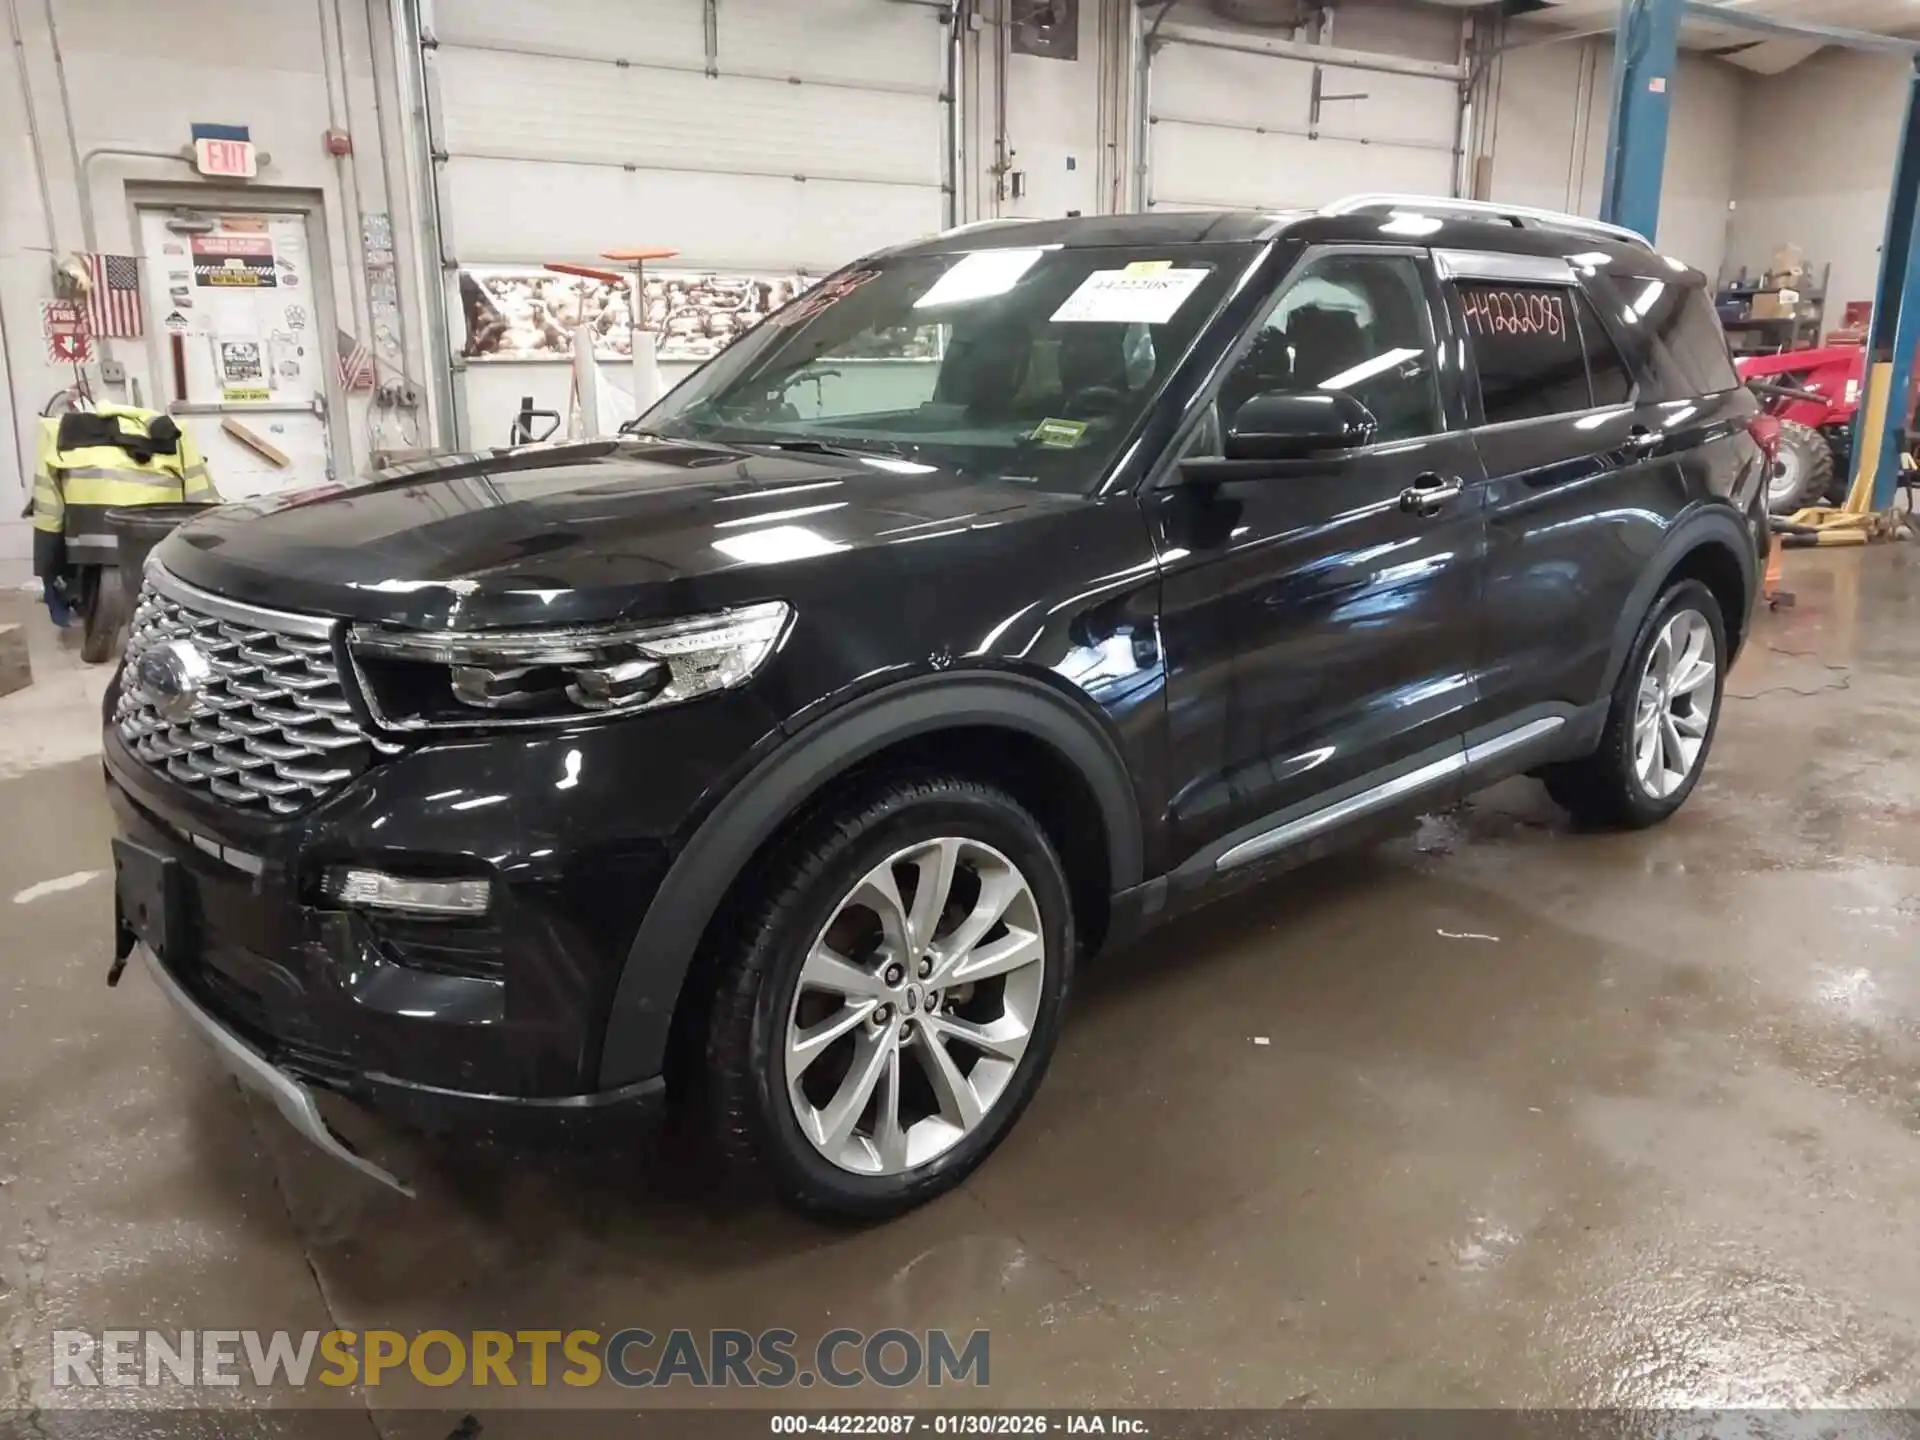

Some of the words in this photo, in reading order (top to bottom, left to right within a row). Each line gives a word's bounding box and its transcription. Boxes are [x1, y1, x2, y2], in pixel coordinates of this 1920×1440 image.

[207, 141, 247, 173] EXIT
[52, 309, 77, 321] FIRE
[1461, 291, 1566, 342] 44222087
